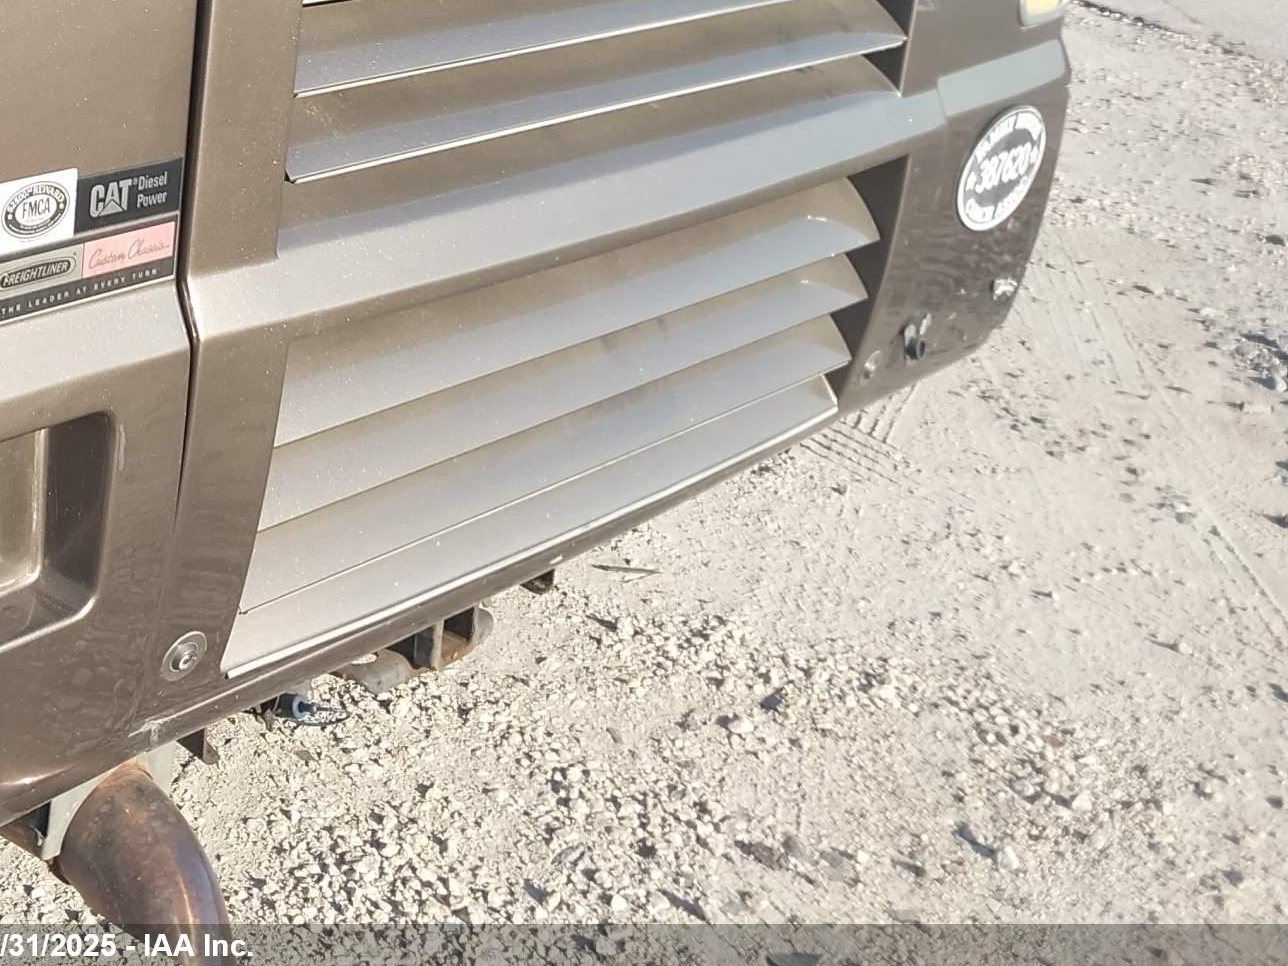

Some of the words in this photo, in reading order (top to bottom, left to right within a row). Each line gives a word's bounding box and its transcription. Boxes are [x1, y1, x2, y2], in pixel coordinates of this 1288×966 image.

[975, 142, 1032, 194] 387620
[22, 197, 51, 219] FMCA
[32, 185, 65, 202] REWARD
[90, 178, 132, 218] CAT
[138, 171, 168, 191] Diesel
[136, 192, 168, 209] Power
[88, 248, 126, 270] Custom
[127, 239, 170, 261] Chassis
[2, 261, 69, 288] FREIGHTLINER
[1, 304, 21, 316] THE
[28, 291, 70, 308] LEADER
[75, 286, 88, 296] AT
[94, 276, 126, 291] EVERY
[132, 268, 158, 280] TURN
